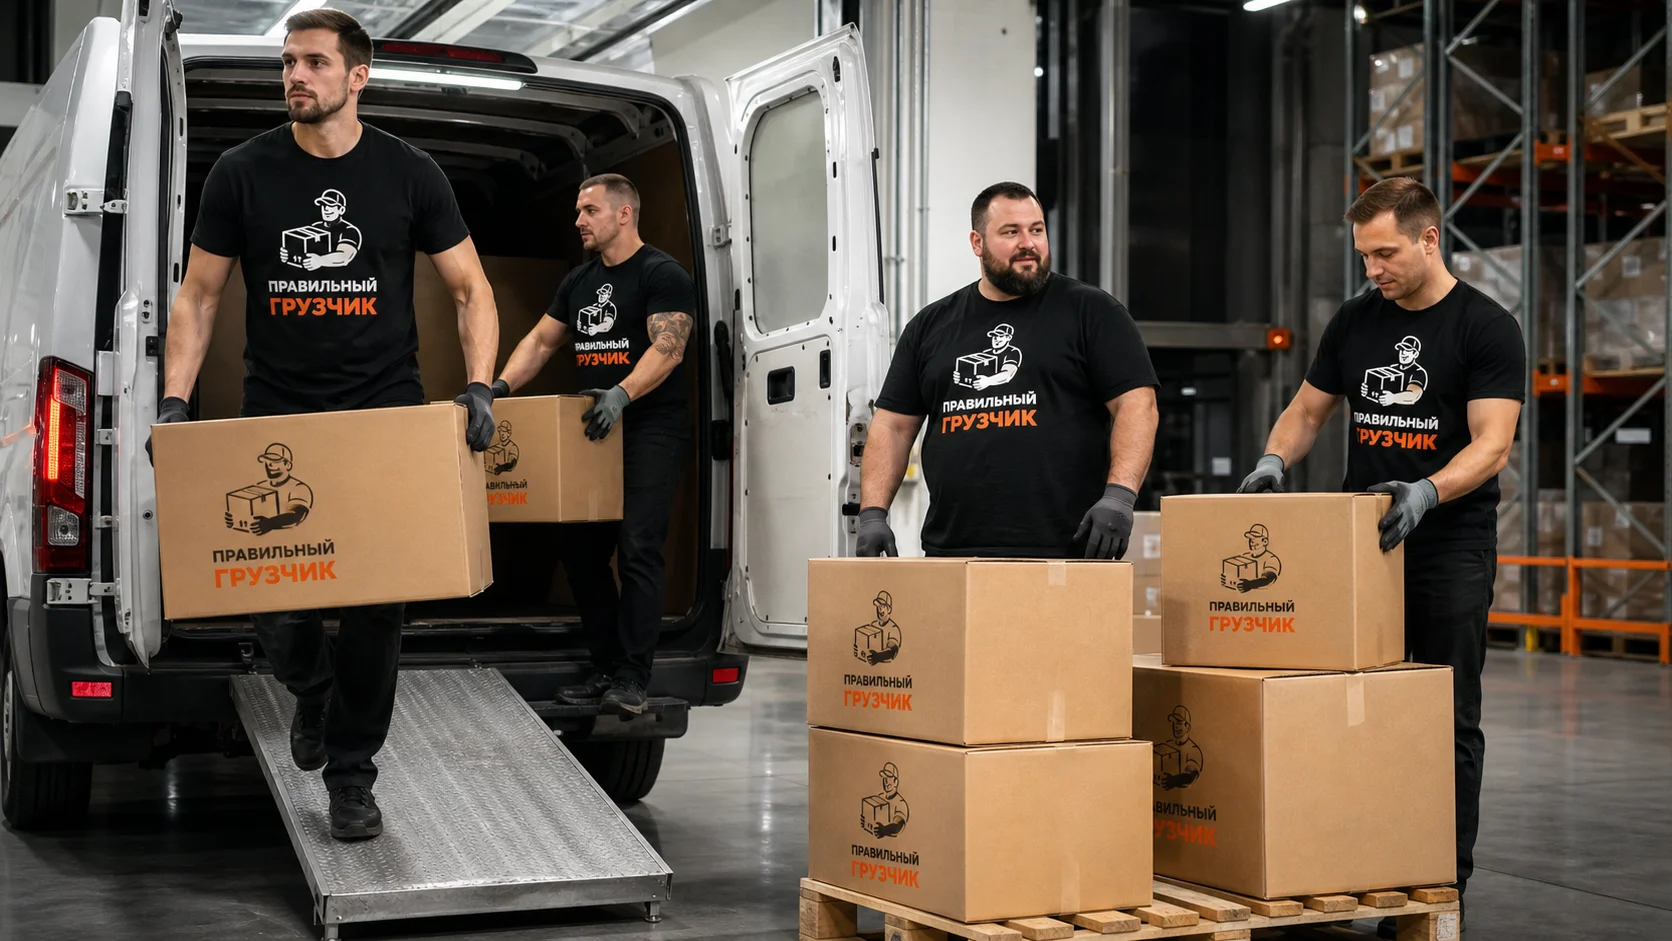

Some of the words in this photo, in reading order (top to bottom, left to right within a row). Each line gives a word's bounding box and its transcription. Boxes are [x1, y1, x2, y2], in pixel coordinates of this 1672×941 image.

[268, 277, 377, 293] ПРАВИЛЬНЫЙ
[270, 297, 377, 316] ГРУЗЧИК
[943, 390, 1037, 413] ПРАВИЛЬНЫЙ
[941, 409, 1038, 434] ГРУЗЧИК
[1354, 411, 1439, 431] ПРАВИЛЬНЫЙ
[1356, 427, 1438, 450] РУЗЧИК
[212, 538, 335, 563] ПРАВИЛЬНЫЙ
[214, 560, 338, 589] ГРУЗЧИК
[1209, 599, 1295, 613] ПРАВИЛЬНЫЙ
[1209, 616, 1296, 633] ГРУЗЧИК
[844, 674, 913, 689] ПРАВИЛЬНЫЙ
[843, 689, 913, 712] ГРУЗЧИК
[1153, 818, 1217, 847] УЗЧИК
[851, 844, 920, 867] ПРАВИЛЬНЫЙ
[851, 860, 920, 889] ГРУЗЧИК
